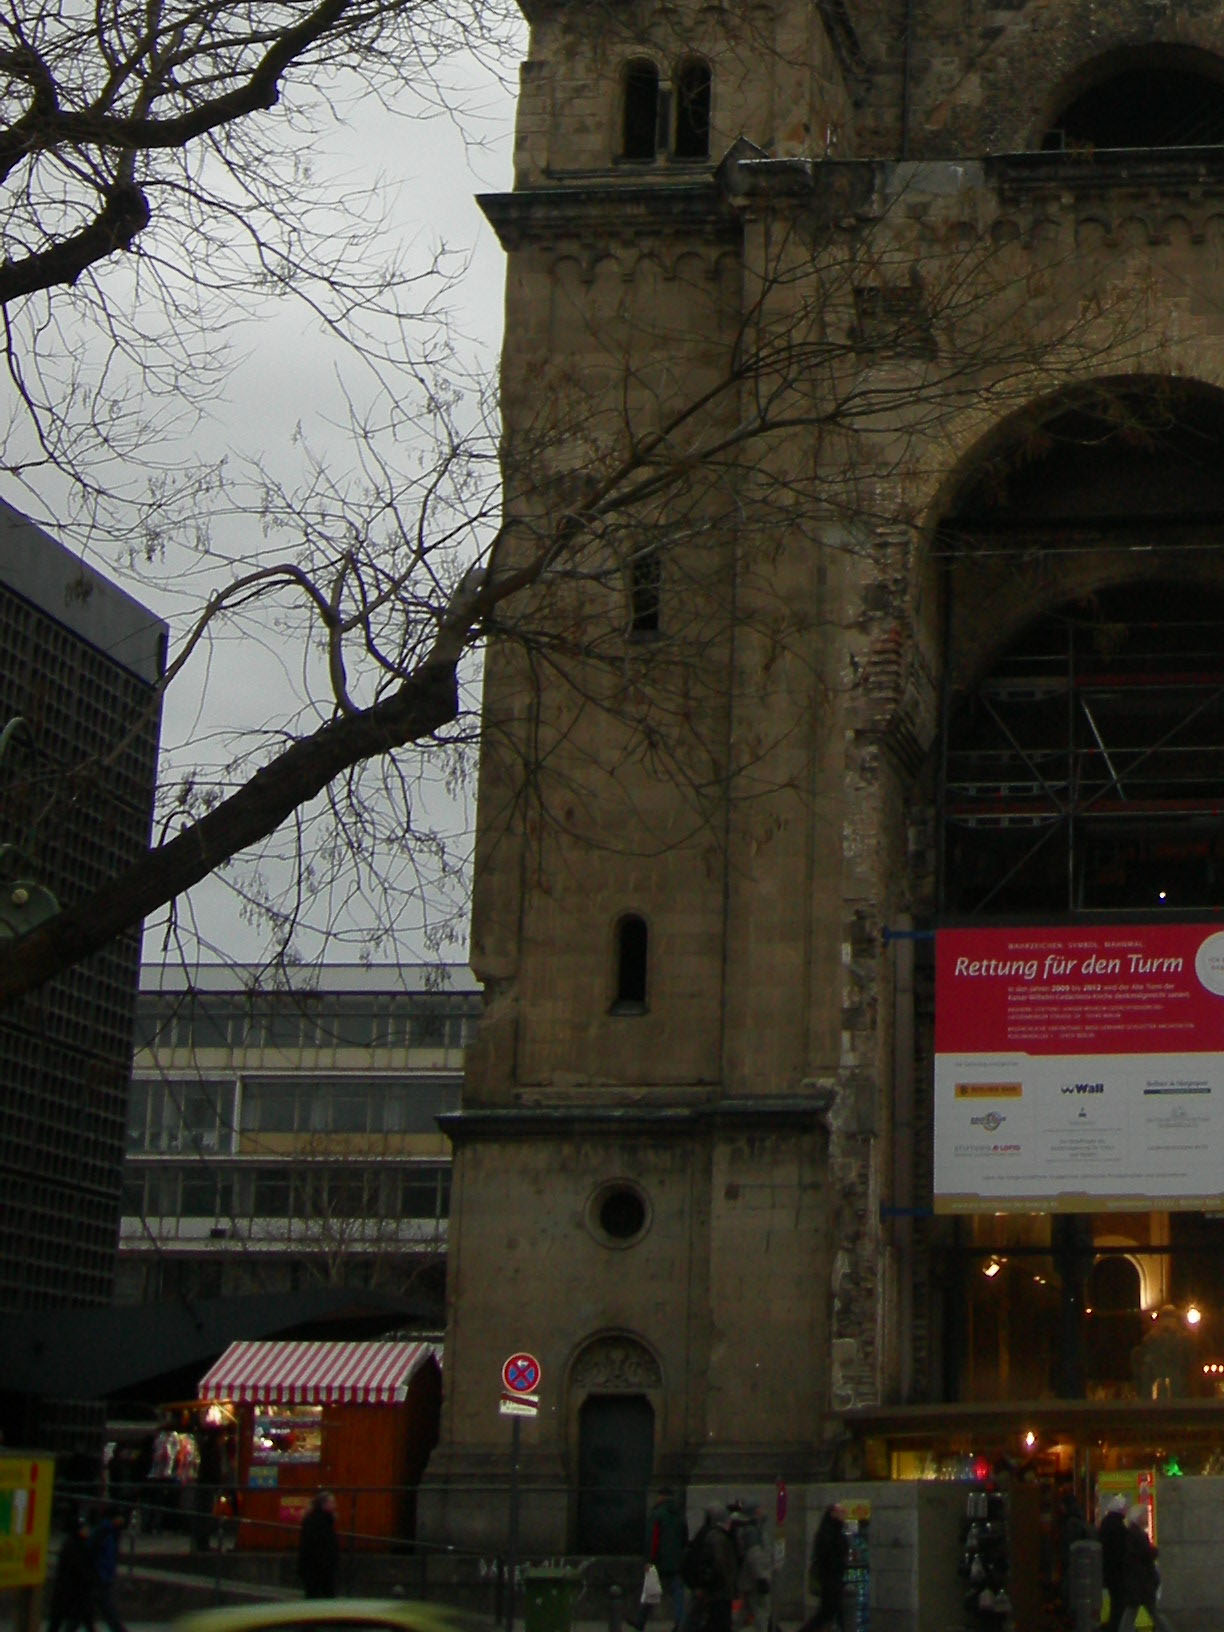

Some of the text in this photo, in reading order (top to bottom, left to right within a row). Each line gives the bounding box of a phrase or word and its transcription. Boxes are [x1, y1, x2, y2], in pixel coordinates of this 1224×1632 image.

[955, 957, 1038, 980] Rettung
[1043, 954, 1078, 979] für
[1081, 954, 1121, 974] den
[1127, 954, 1183, 973] Turm
[1075, 1083, 1104, 1094] Wall
